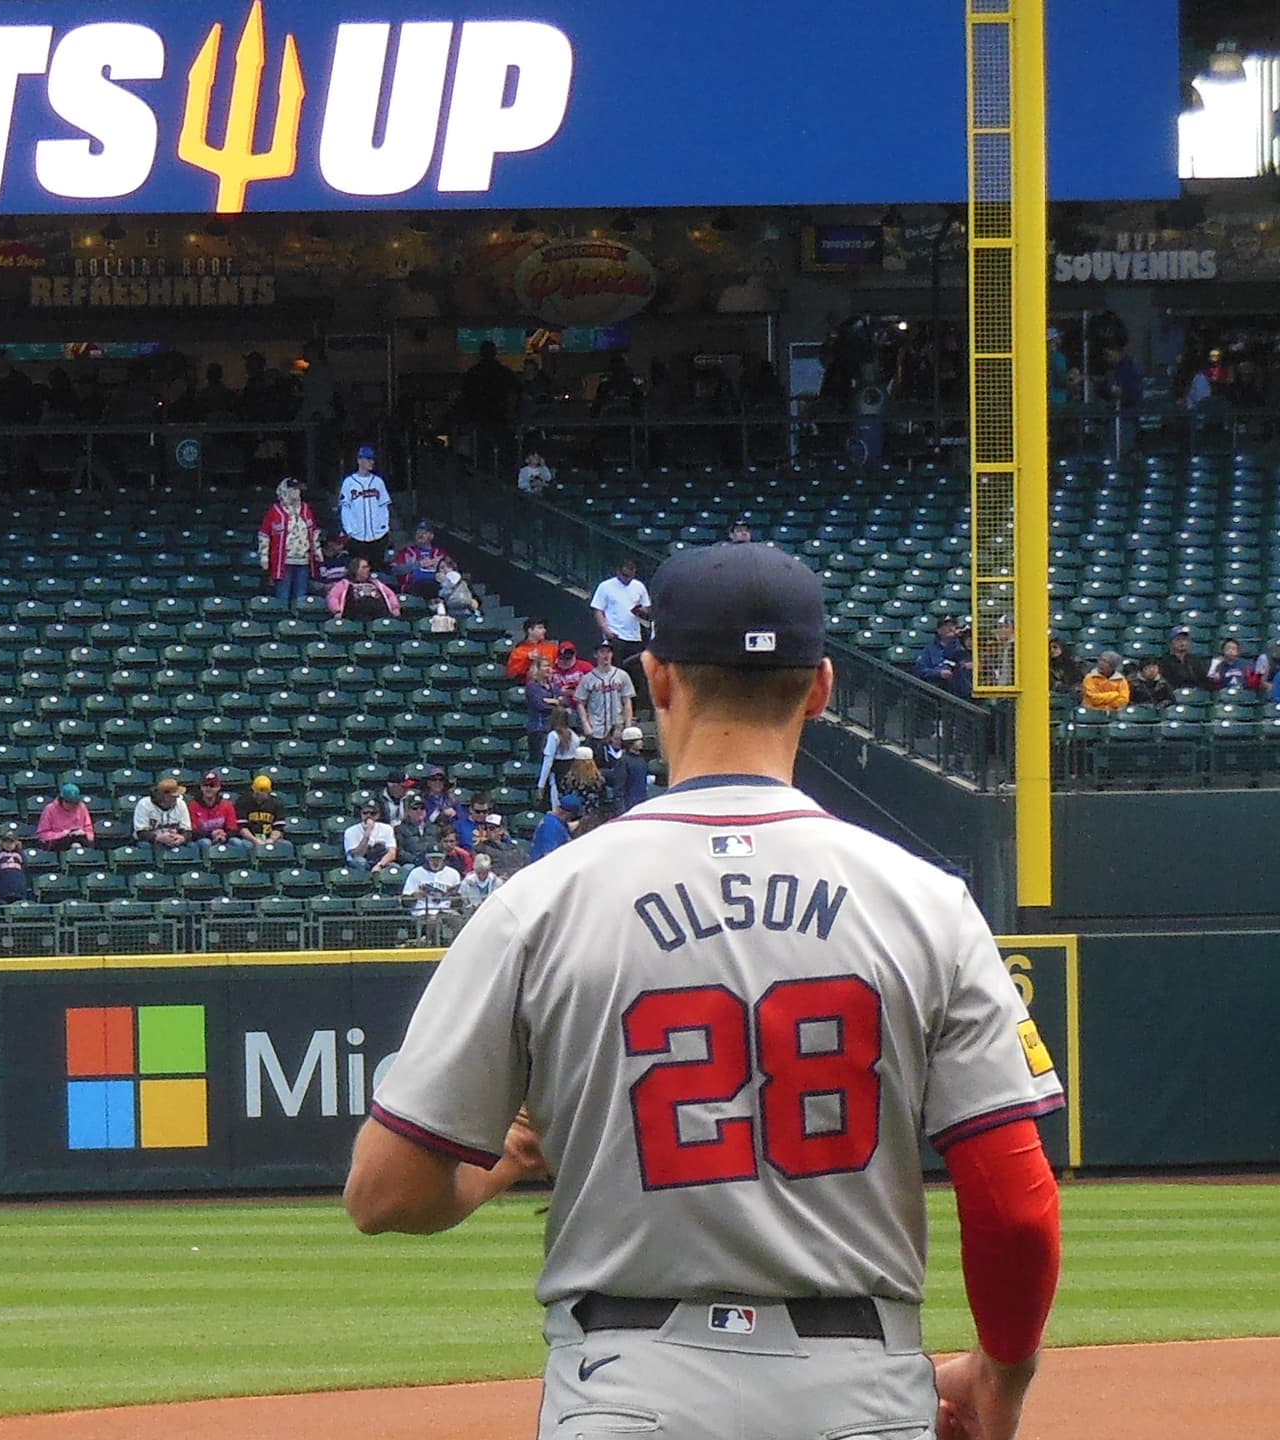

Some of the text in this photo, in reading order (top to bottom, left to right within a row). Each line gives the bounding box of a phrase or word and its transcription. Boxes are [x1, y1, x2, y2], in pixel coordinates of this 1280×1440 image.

[317, 18, 574, 196] UP
[31, 275, 276, 306] REFRESHMENTS
[1054, 249, 1218, 283] SOUVENIRS
[633, 872, 848, 953] OLSON
[621, 972, 883, 1193] 28
